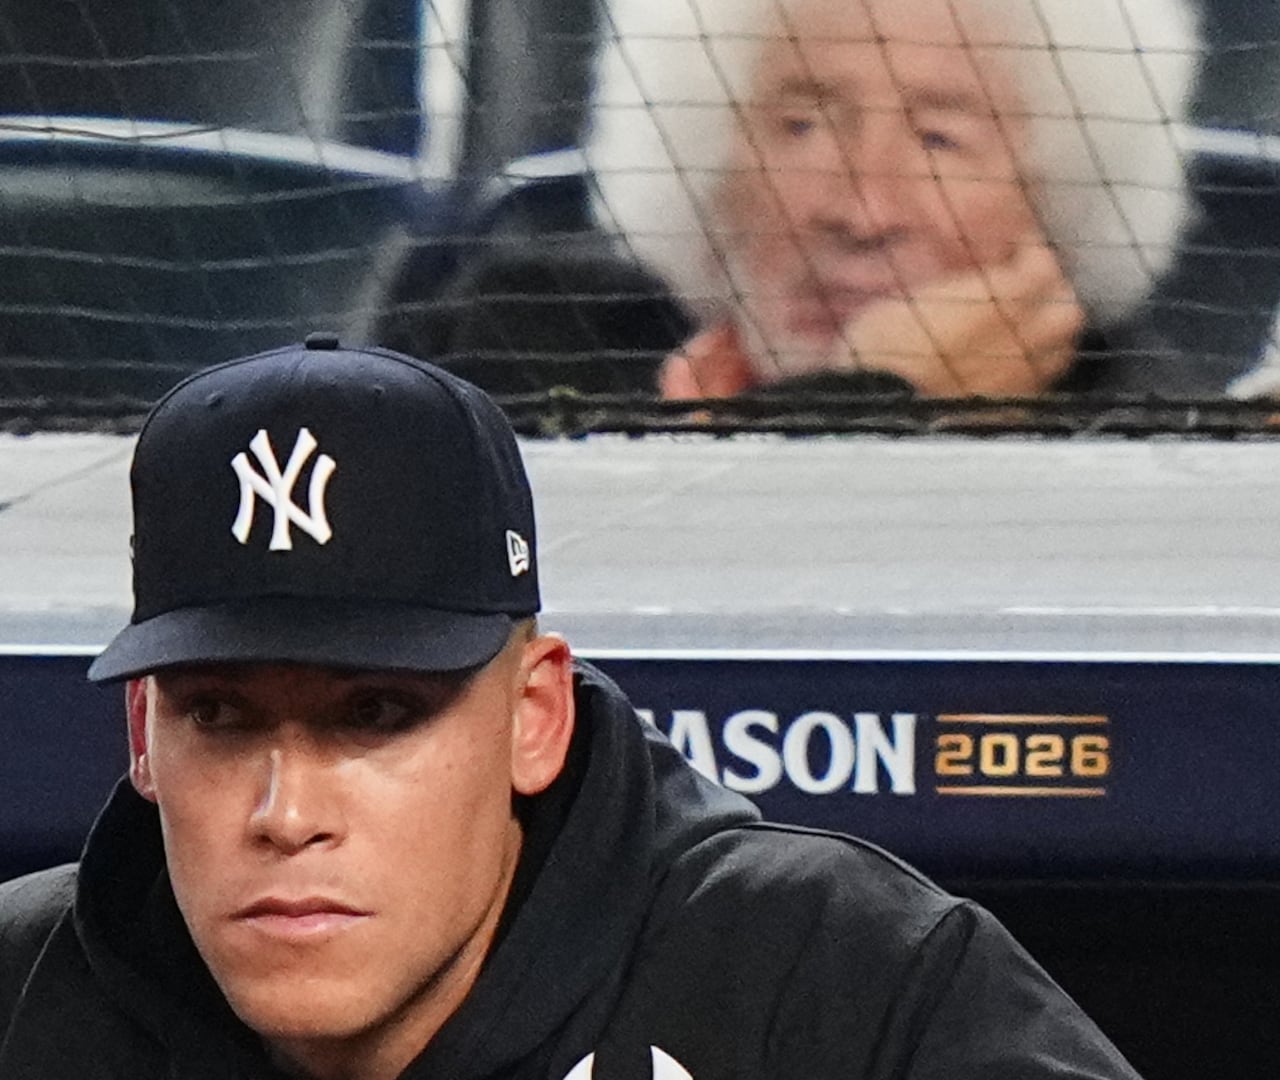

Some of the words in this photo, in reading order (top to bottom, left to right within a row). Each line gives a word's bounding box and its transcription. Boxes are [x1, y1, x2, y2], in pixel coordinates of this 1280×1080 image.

[231, 427, 336, 551] NY
[634, 708, 917, 795] ASON
[935, 733, 1110, 777] 2026
